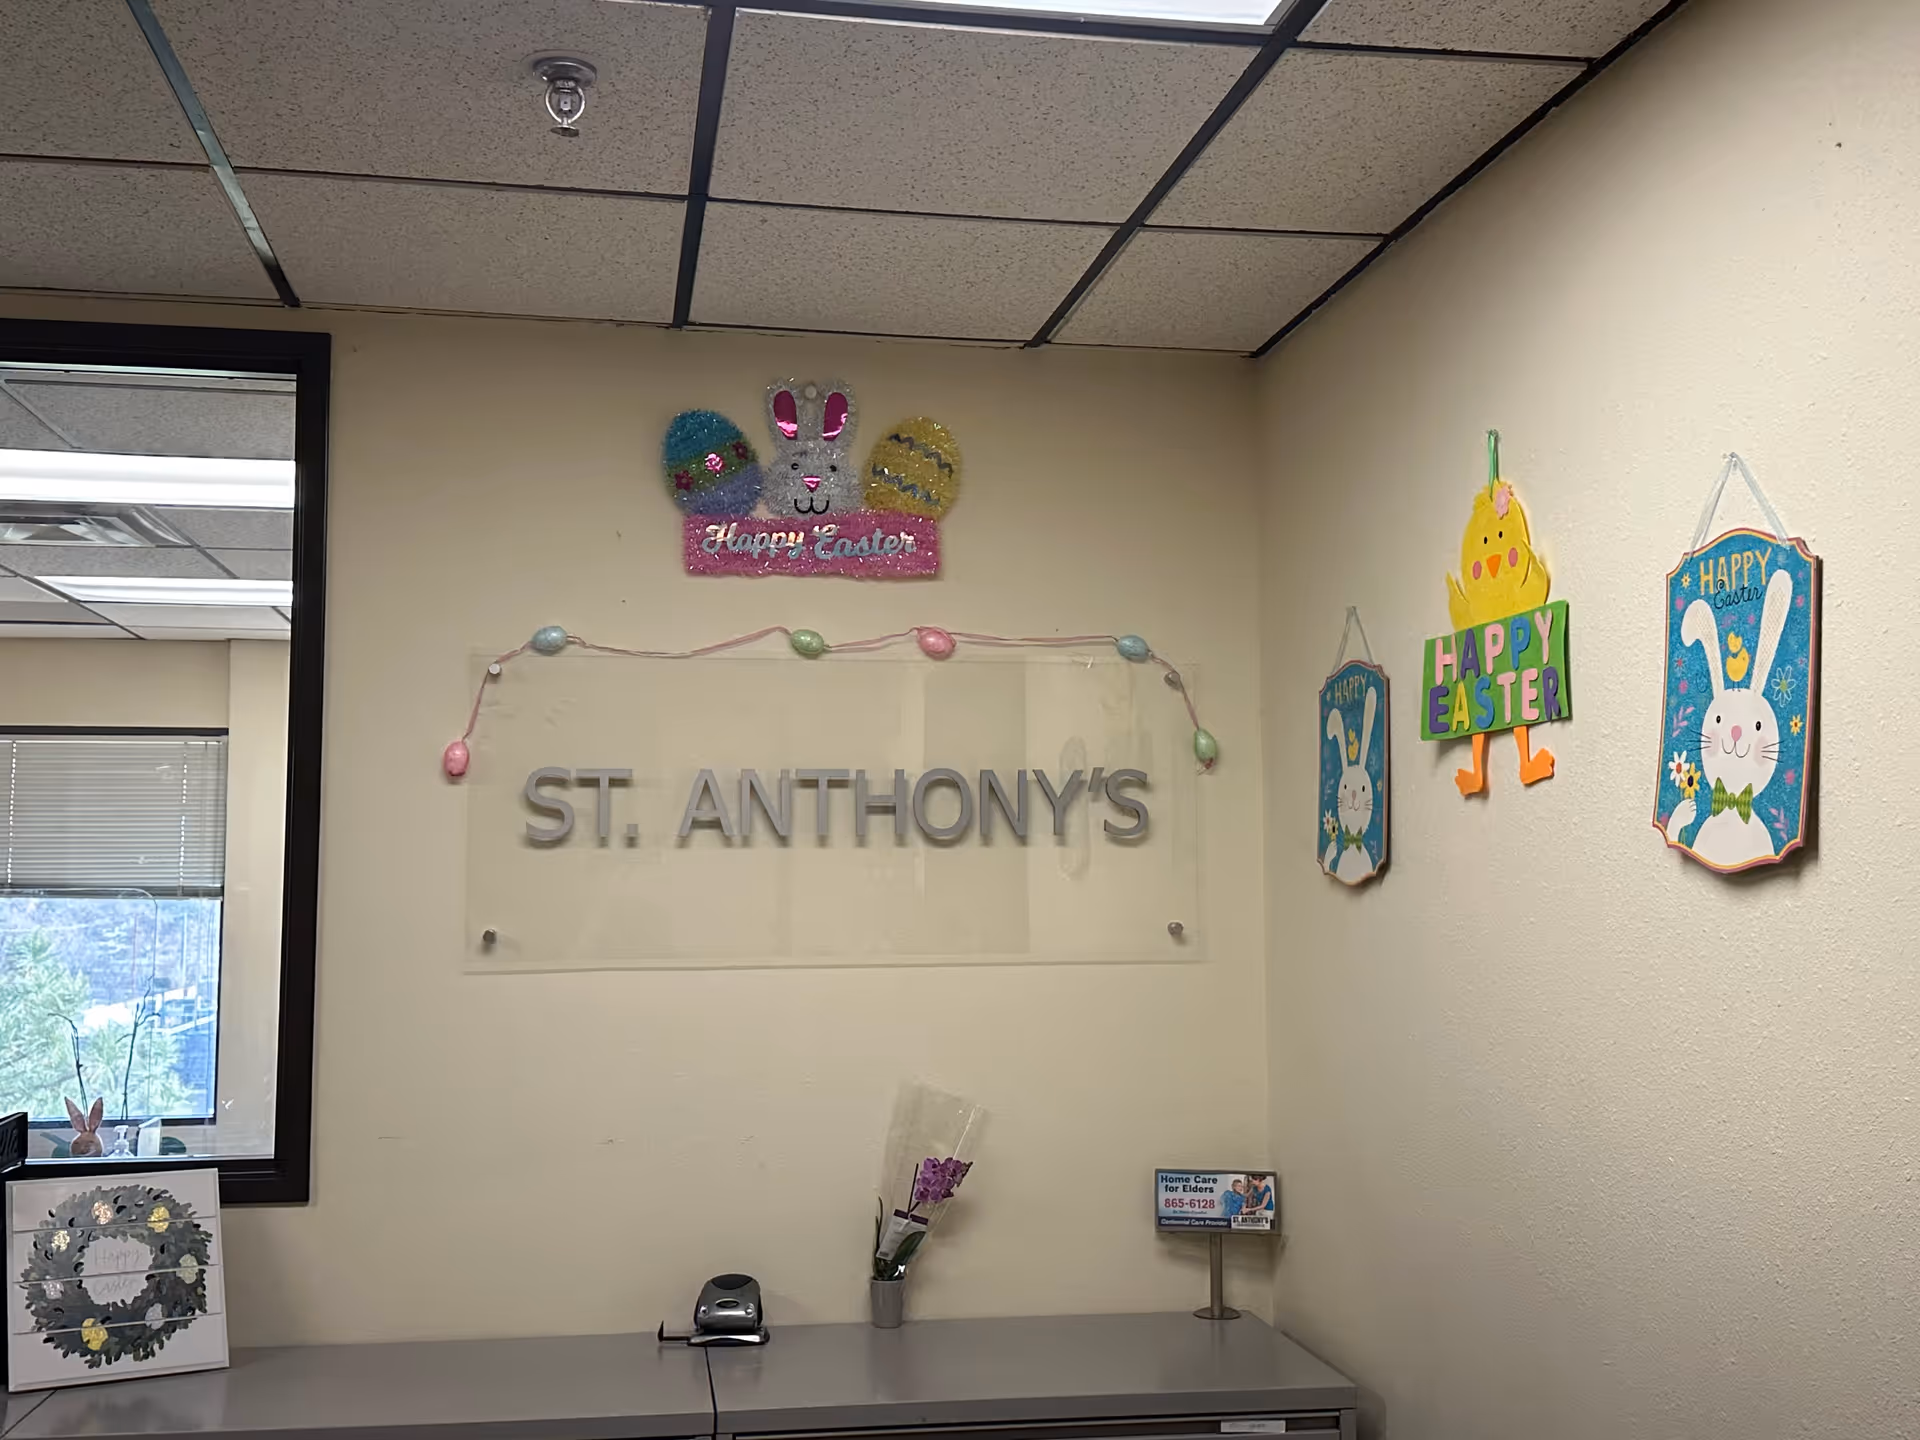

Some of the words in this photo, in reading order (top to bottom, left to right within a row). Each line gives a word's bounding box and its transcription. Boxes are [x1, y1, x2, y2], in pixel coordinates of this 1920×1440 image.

[702, 522, 805, 559] Happy
[812, 523, 918, 560] Easter
[1699, 547, 1772, 596] HAPPY
[1713, 578, 1763, 610] Easter
[1435, 608, 1554, 687] HAPPY
[1334, 672, 1368, 705] HAPPY
[1429, 666, 1561, 734] EASTER
[525, 766, 639, 842] ST.
[677, 766, 1150, 841] ANTHONY'S
[1160, 1174, 1191, 1184] Home
[1193, 1175, 1218, 1185] Care
[1164, 1184, 1180, 1193] for
[1182, 1184, 1215, 1194] Elders
[1164, 1197, 1216, 1210] 865-6128
